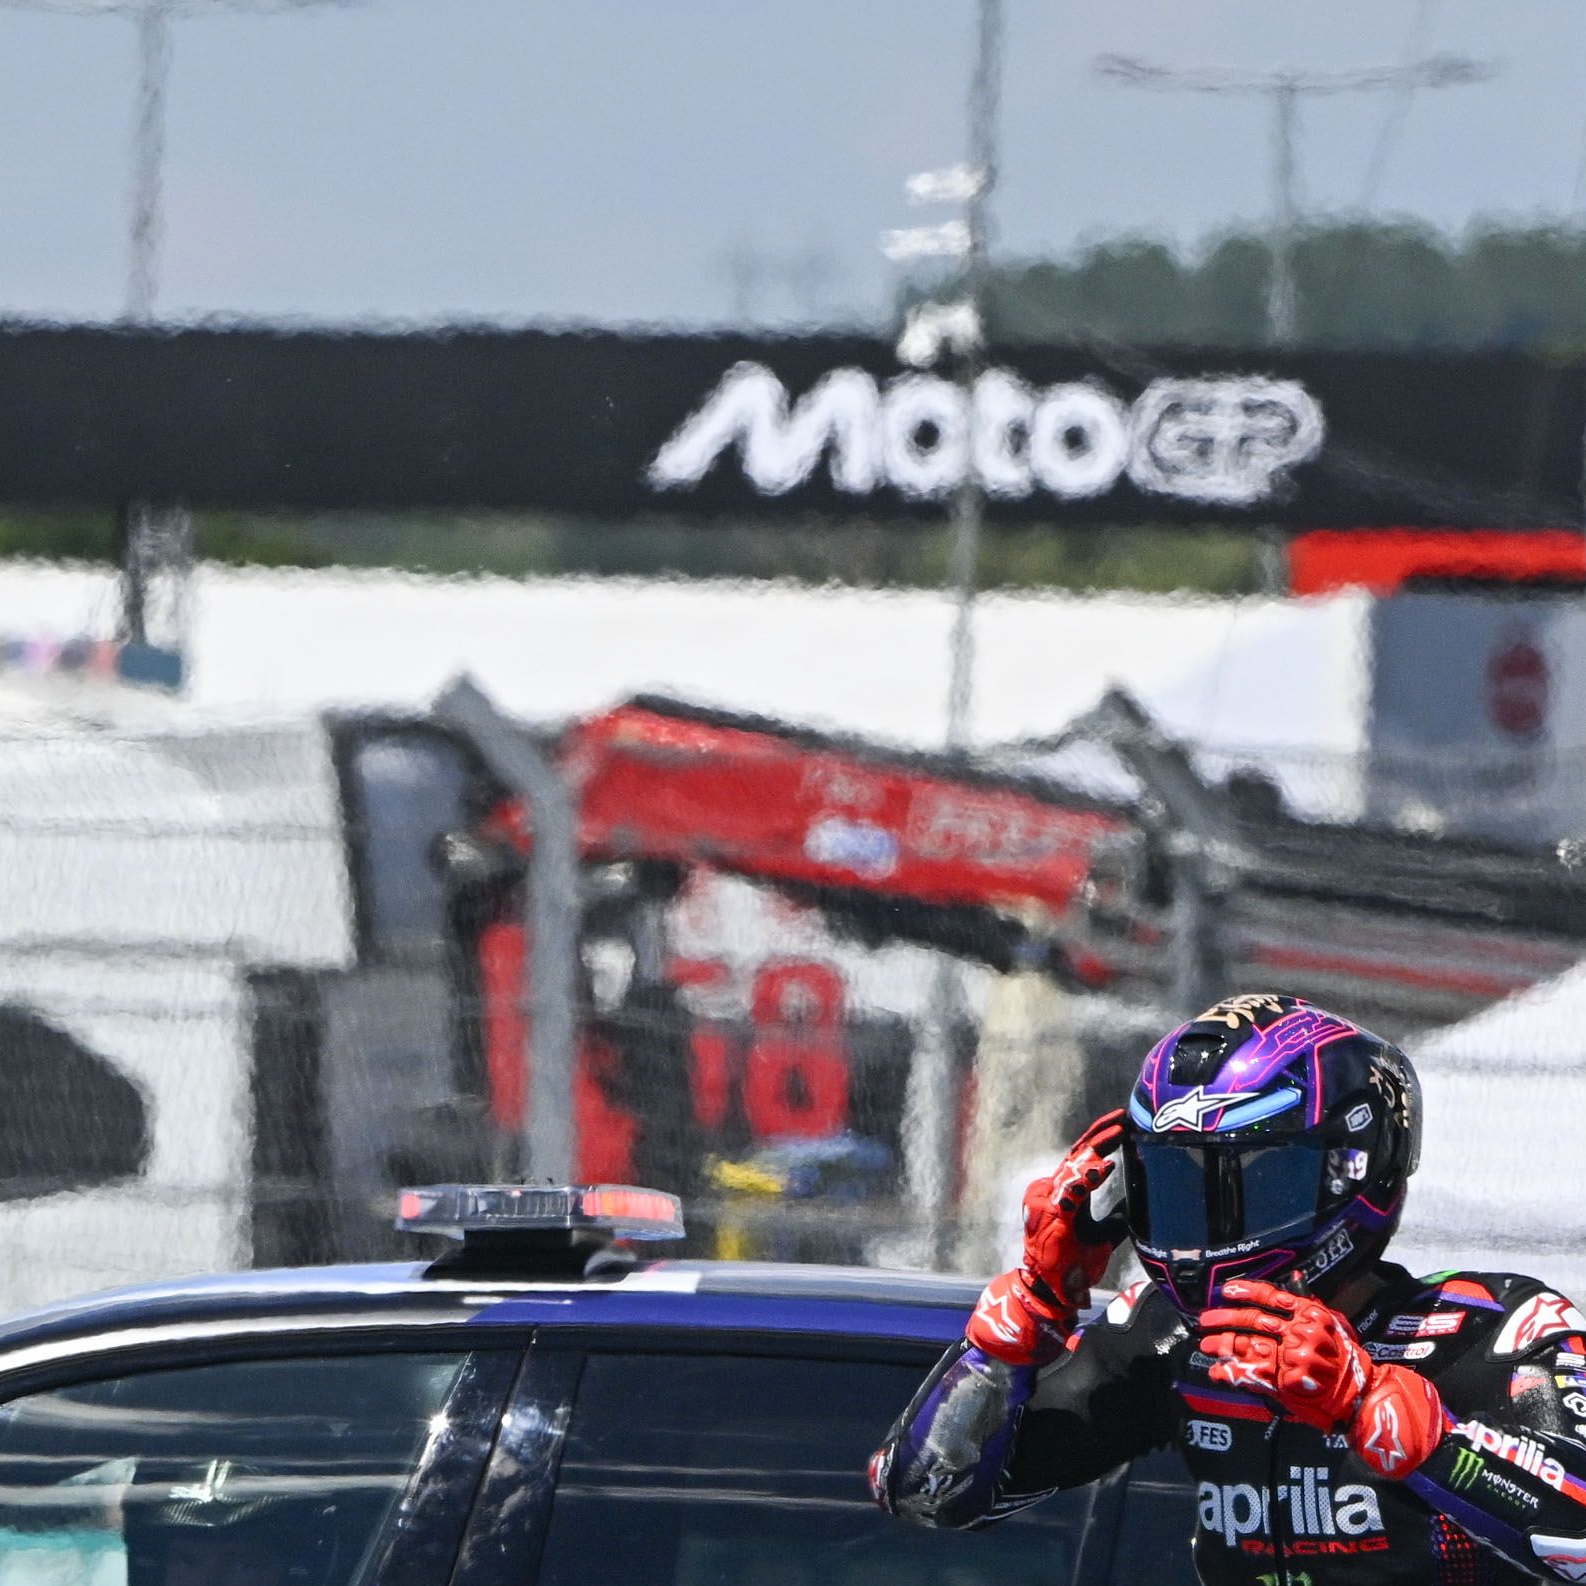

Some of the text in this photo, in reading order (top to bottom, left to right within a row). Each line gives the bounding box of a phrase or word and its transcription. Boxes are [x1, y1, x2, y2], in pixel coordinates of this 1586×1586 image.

[644, 360, 1325, 506] MotoGP
[1205, 1238, 1261, 1258] Breathe Right
[1377, 1345, 1431, 1359] Castrol
[1200, 1425, 1229, 1447] FES
[1451, 1419, 1567, 1491] aprilia
[1197, 1465, 1386, 1547] aprilia
[1240, 1536, 1391, 1558] RACING
